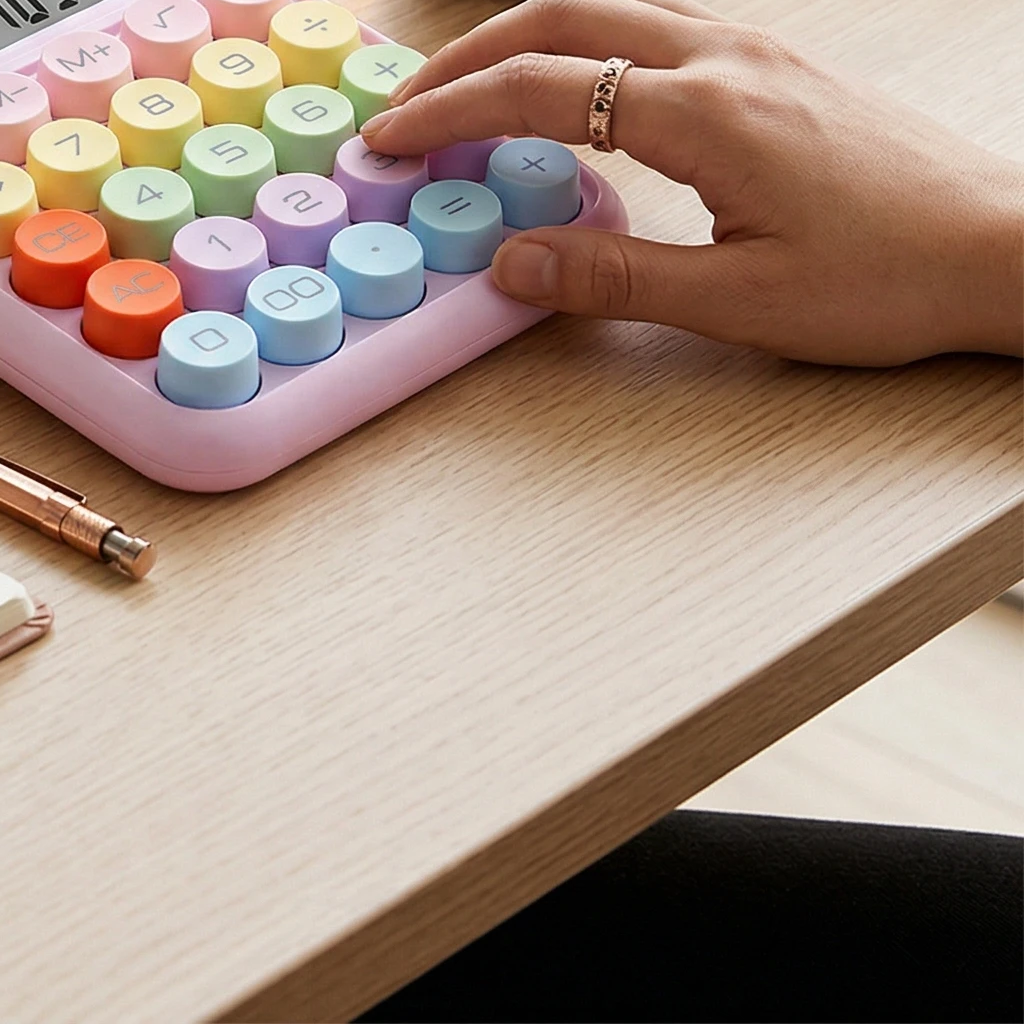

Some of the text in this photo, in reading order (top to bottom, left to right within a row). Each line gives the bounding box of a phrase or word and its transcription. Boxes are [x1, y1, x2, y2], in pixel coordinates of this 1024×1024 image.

[56, 44, 111, 73] M+
[219, 53, 255, 75] 9
[138, 93, 175, 116] 8
[291, 100, 328, 122] 6
[54, 132, 81, 156] 7
[208, 139, 249, 165] 5
[136, 183, 164, 205] 4
[282, 189, 324, 214] 2
[32, 222, 90, 254] CE
[208, 233, 232, 253] 1
[111, 271, 165, 304] AC
[189, 328, 229, 352] 0
